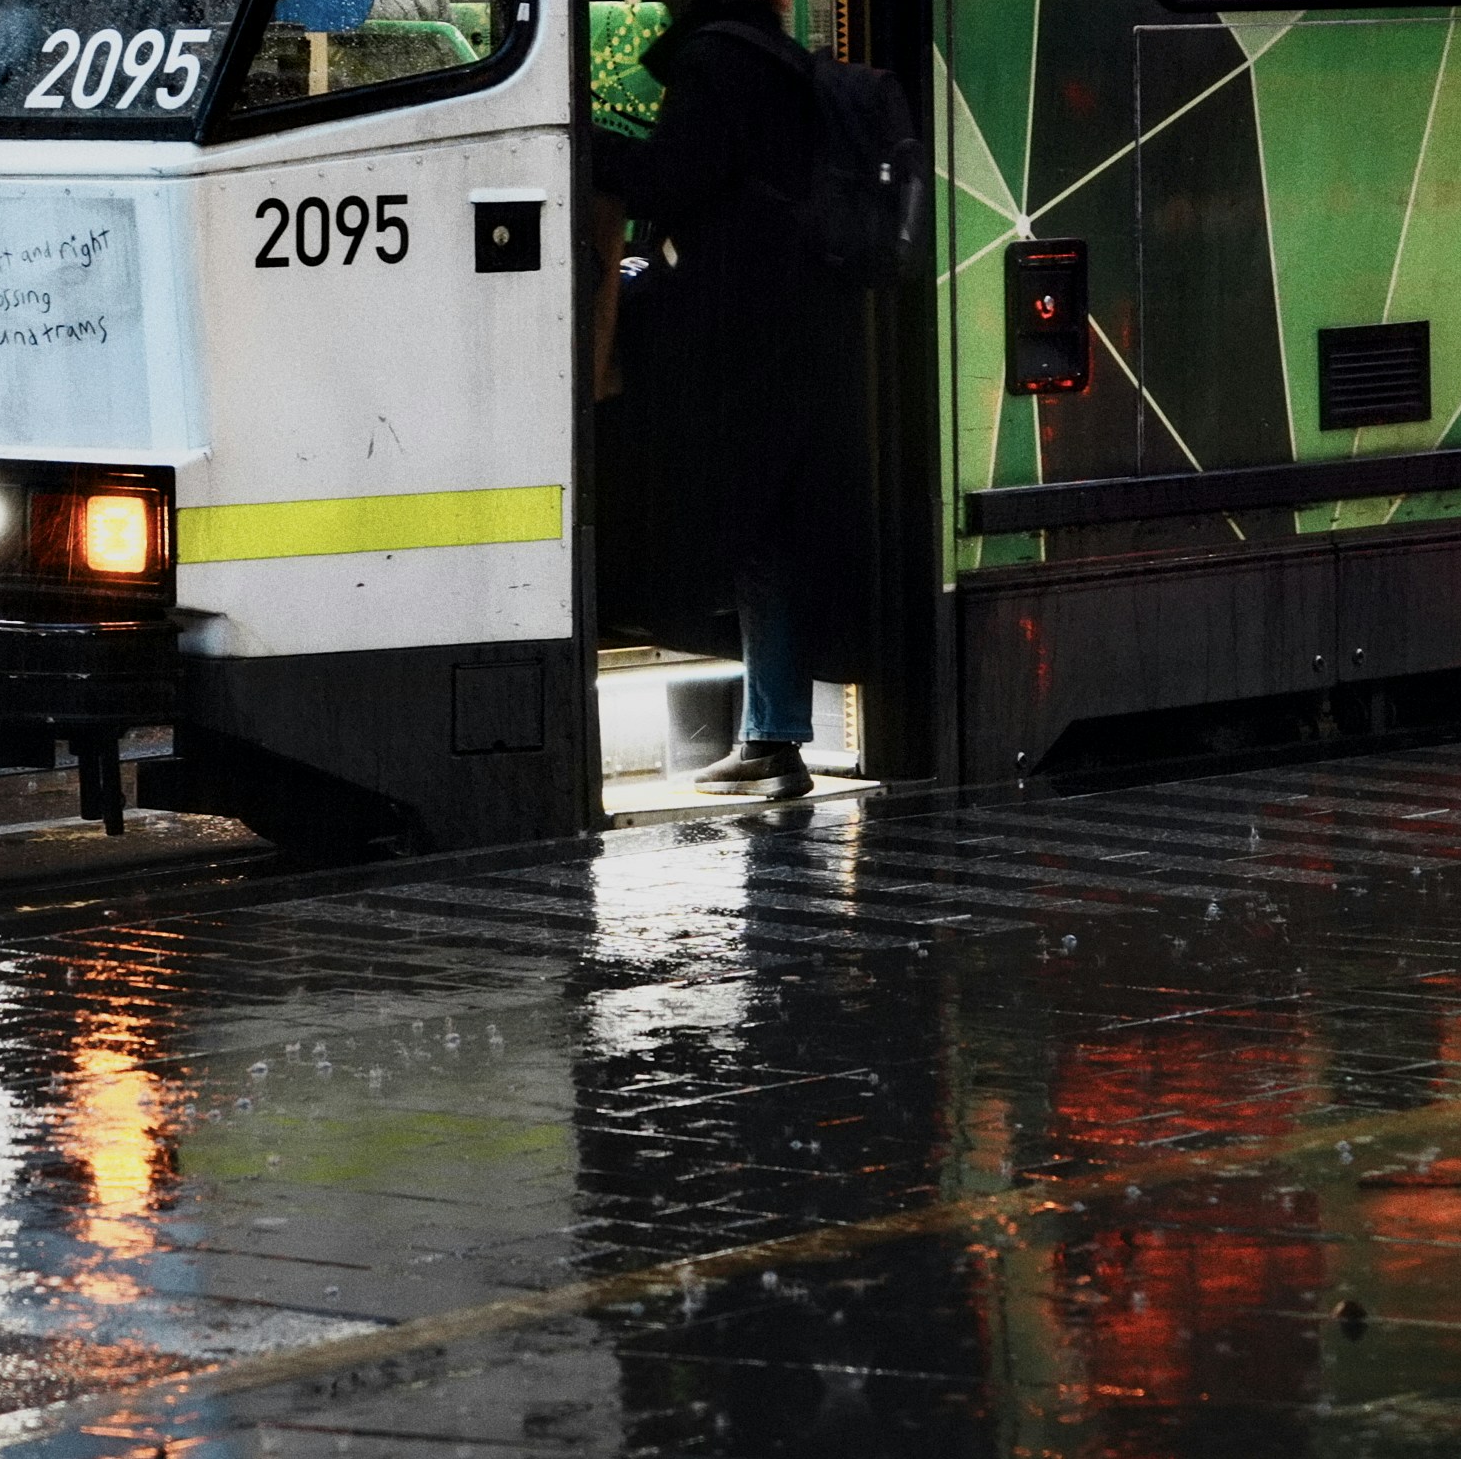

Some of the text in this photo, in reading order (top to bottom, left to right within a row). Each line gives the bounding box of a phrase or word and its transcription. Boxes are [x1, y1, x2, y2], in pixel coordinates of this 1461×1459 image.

[24, 28, 212, 110] 2095
[20, 241, 52, 264] and
[59, 229, 110, 268] right
[254, 194, 409, 269] 2095
[41, 315, 109, 345] trams
